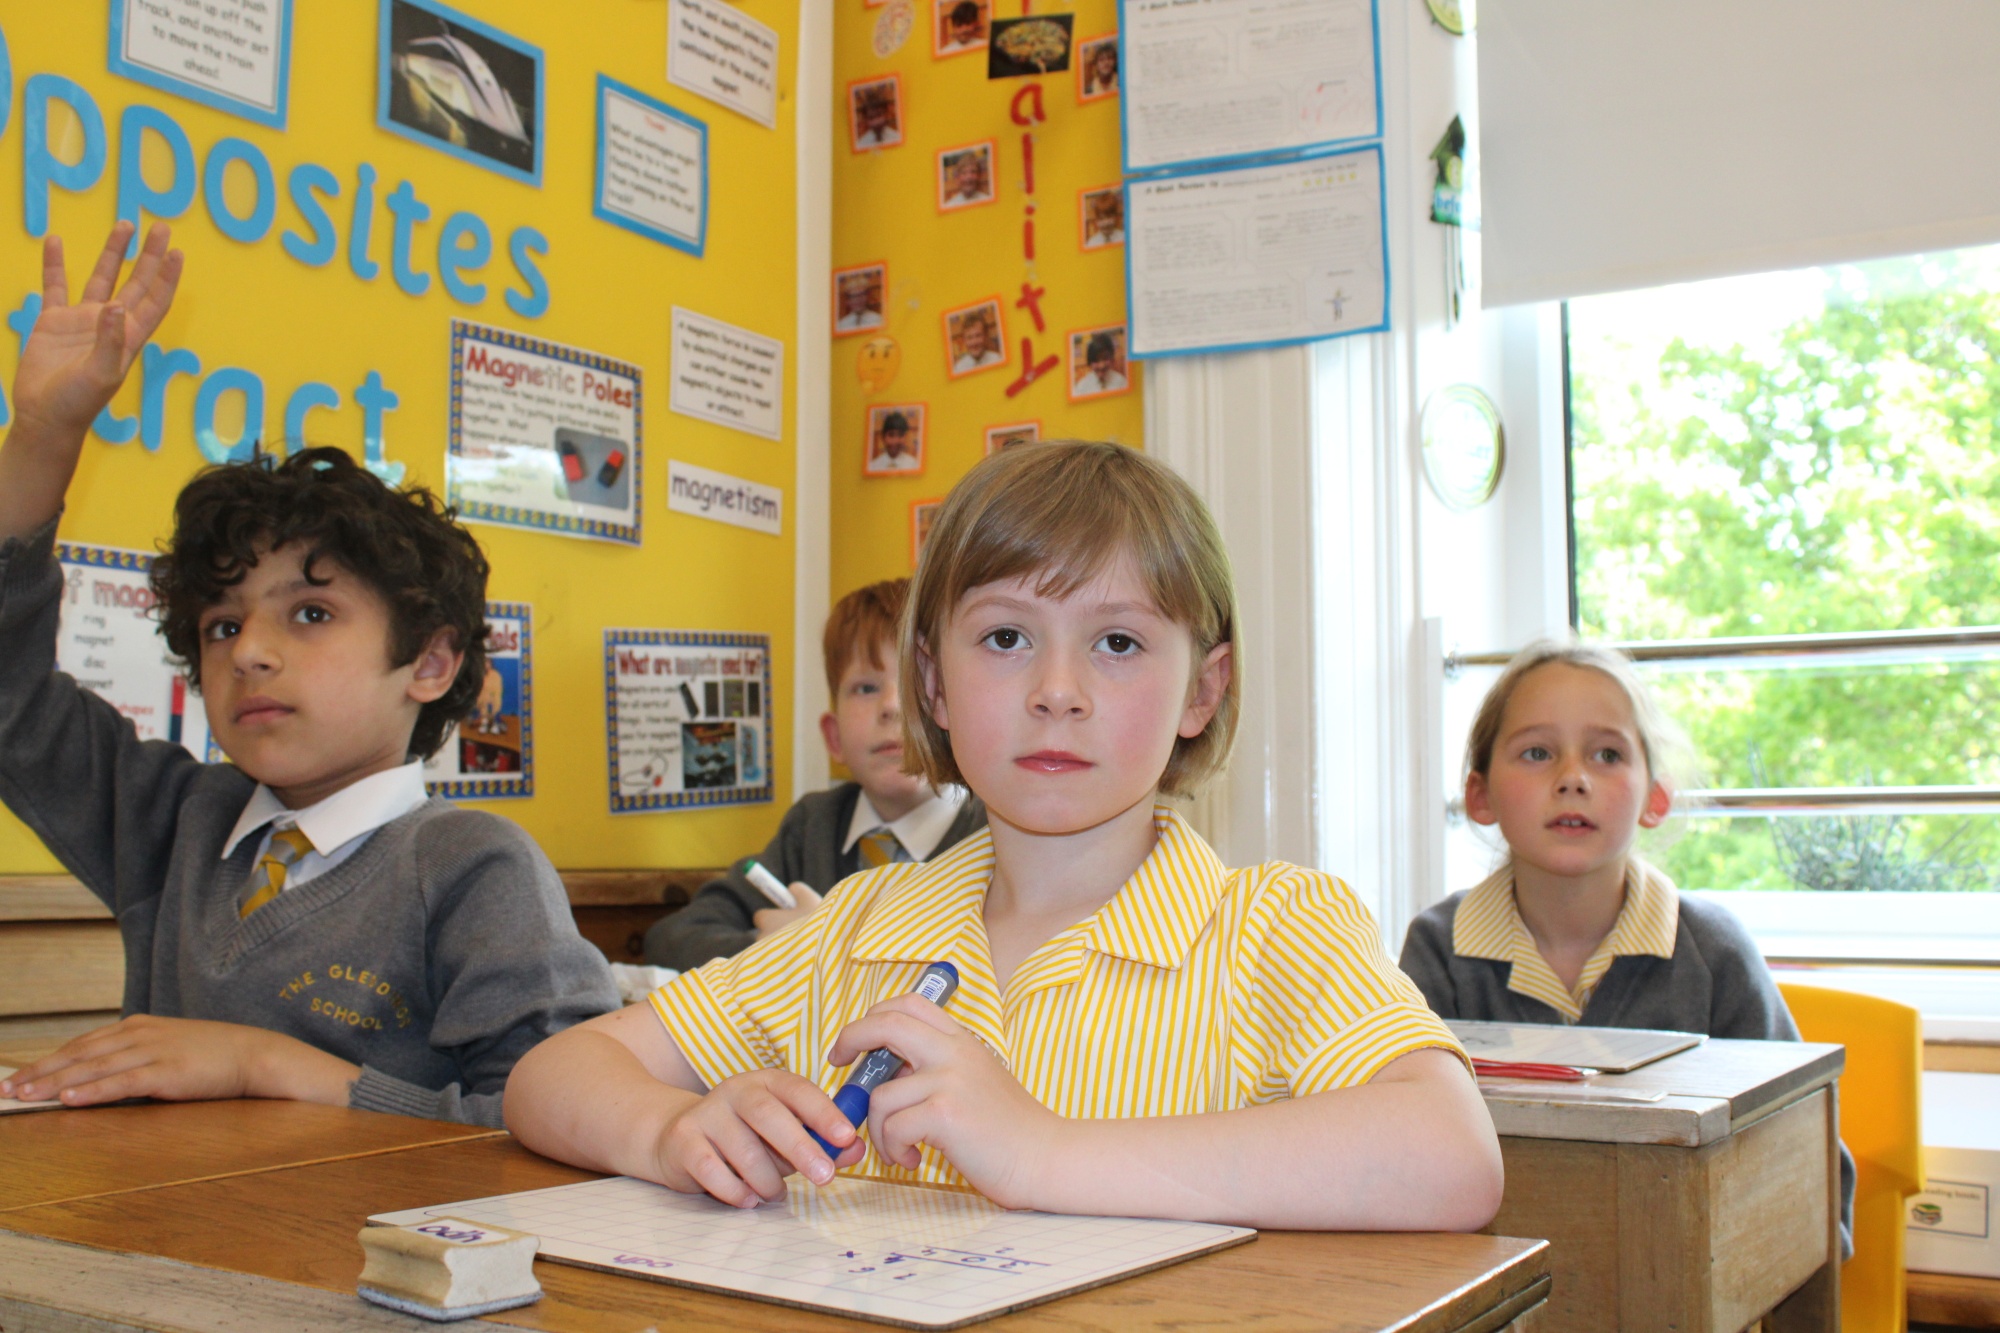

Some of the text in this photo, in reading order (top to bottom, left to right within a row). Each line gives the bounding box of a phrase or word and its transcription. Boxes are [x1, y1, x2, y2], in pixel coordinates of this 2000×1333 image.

[0, 24, 550, 318] pposites
[465, 345, 634, 409] Magnetic Poles
[672, 474, 779, 522] magnetism
[278, 971, 316, 1001] THE
[310, 997, 383, 1031] SCHOOL
